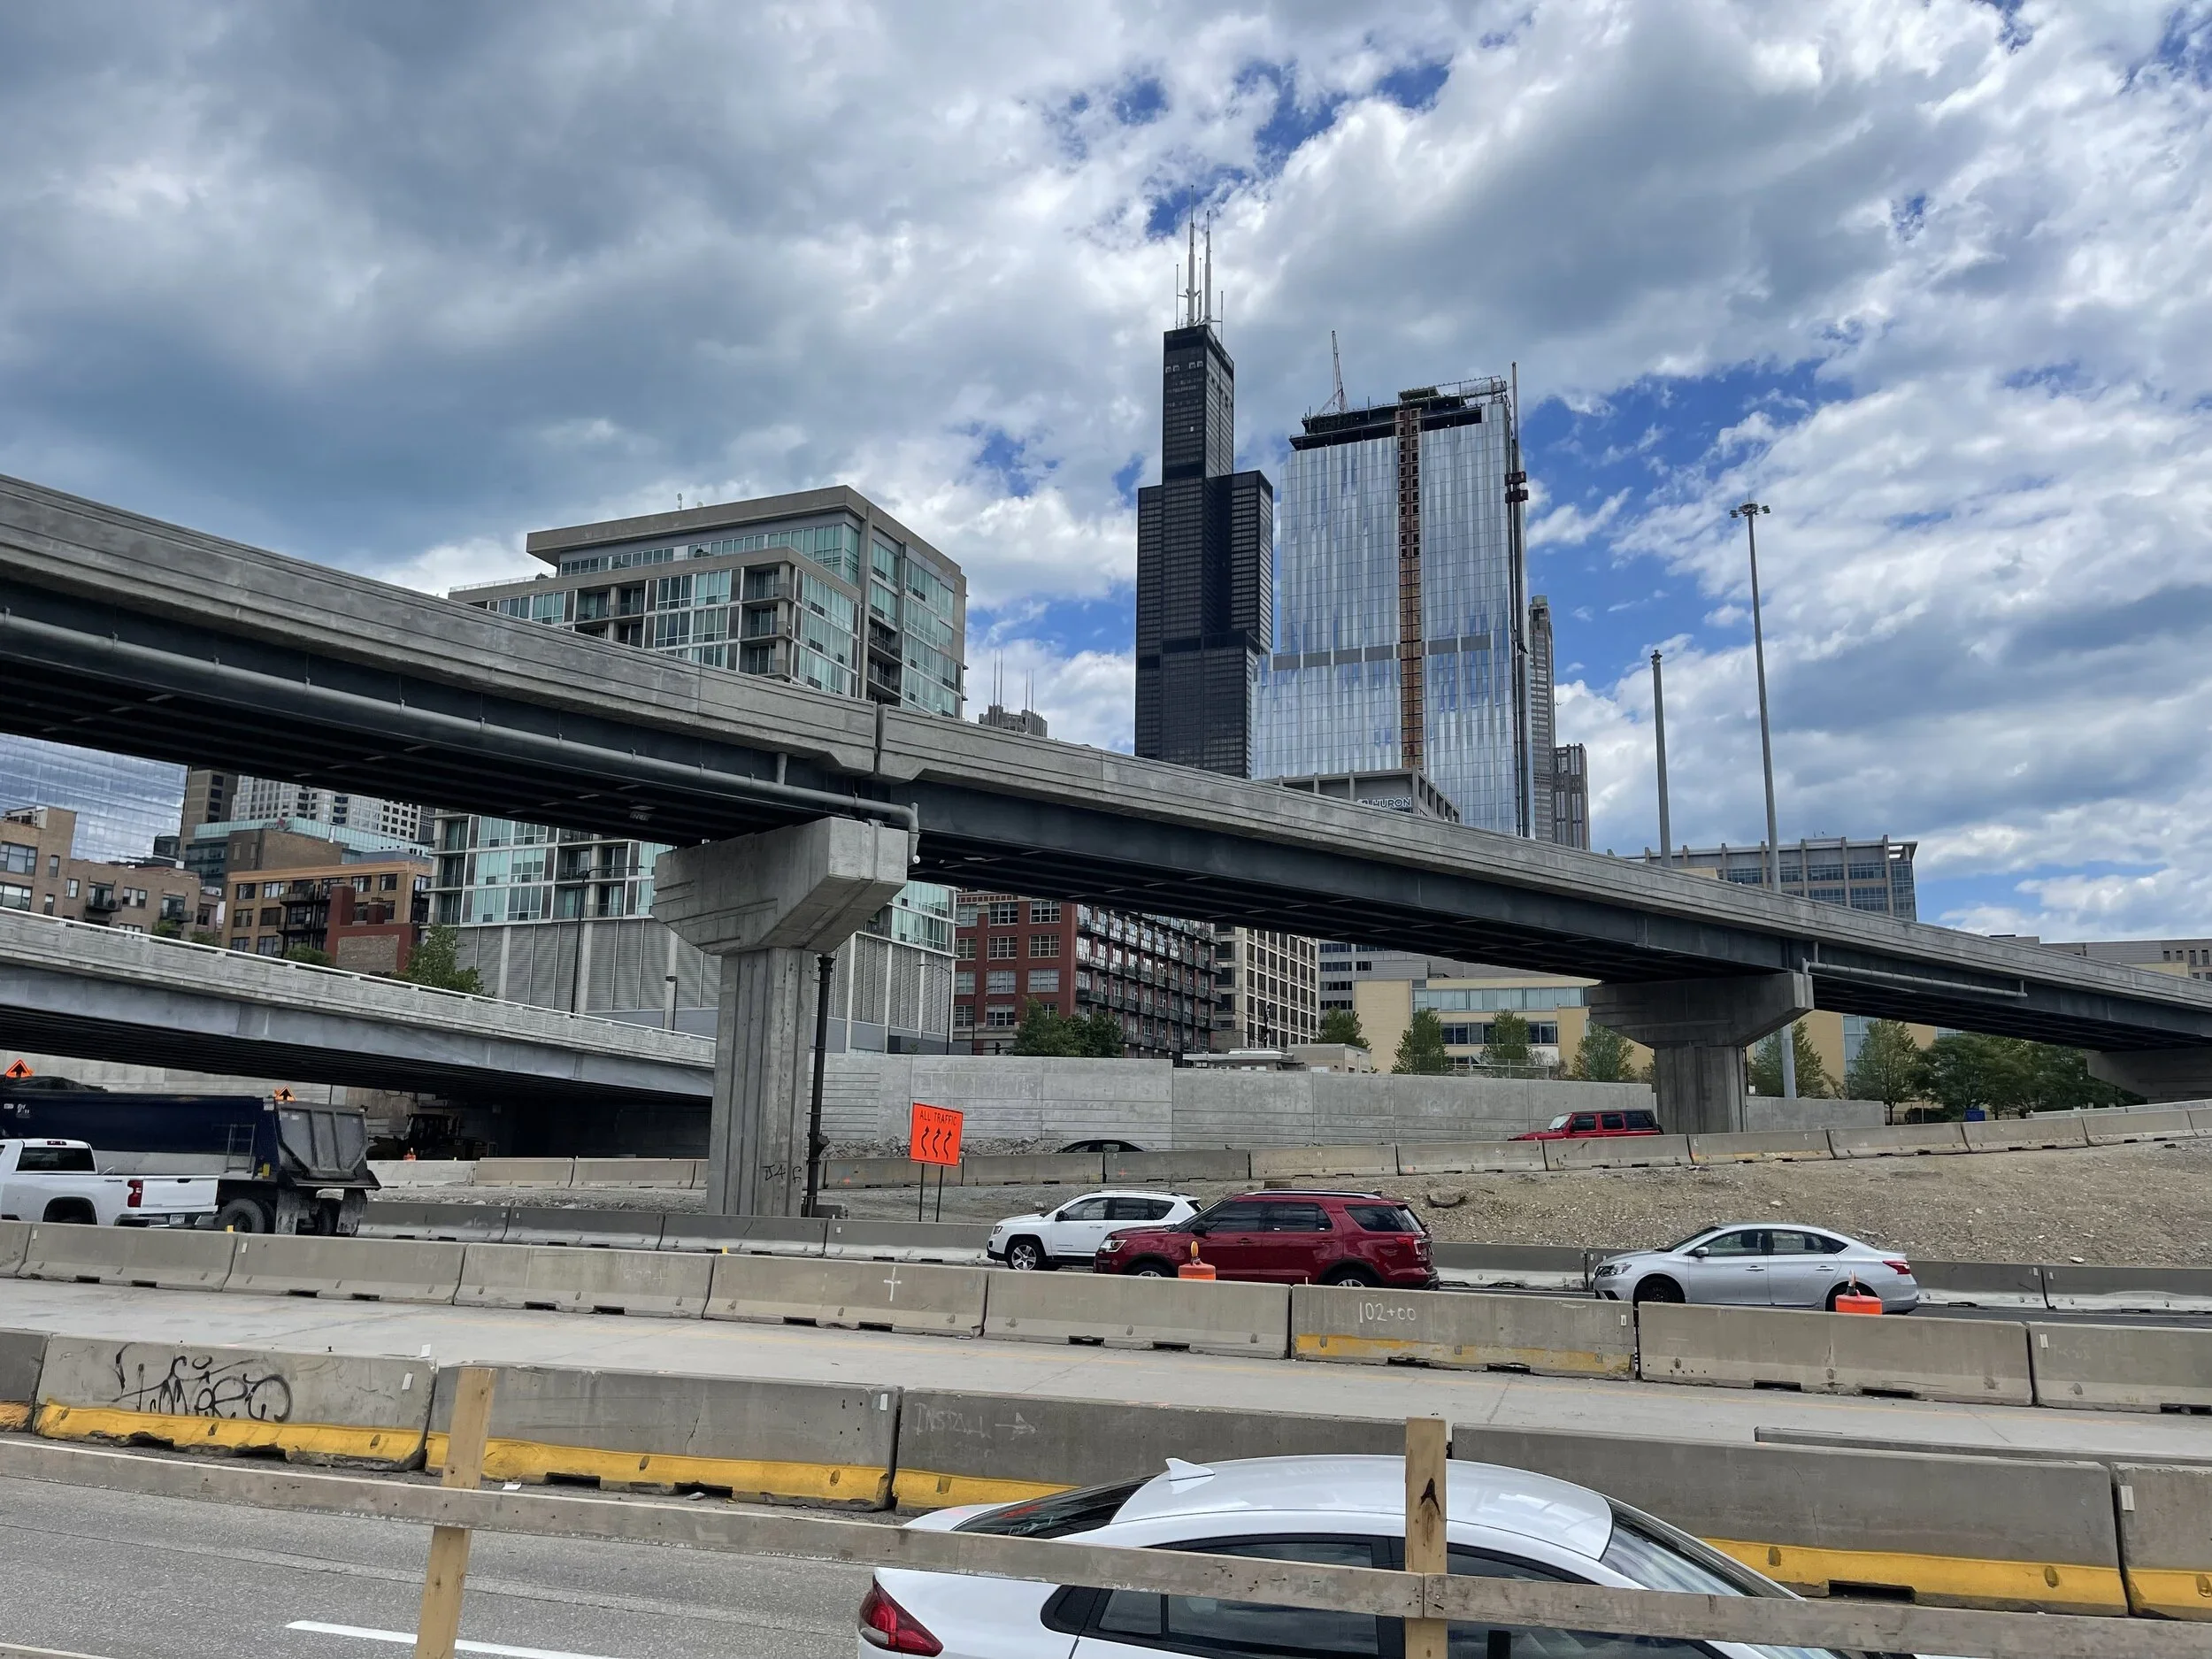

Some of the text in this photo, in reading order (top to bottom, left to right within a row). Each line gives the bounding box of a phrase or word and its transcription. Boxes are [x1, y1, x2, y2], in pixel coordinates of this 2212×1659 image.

[1372, 797, 1411, 808] HURON
[919, 1110, 957, 1126] ALL TRAFFIC
[1359, 1302, 1417, 1324] 102+00
